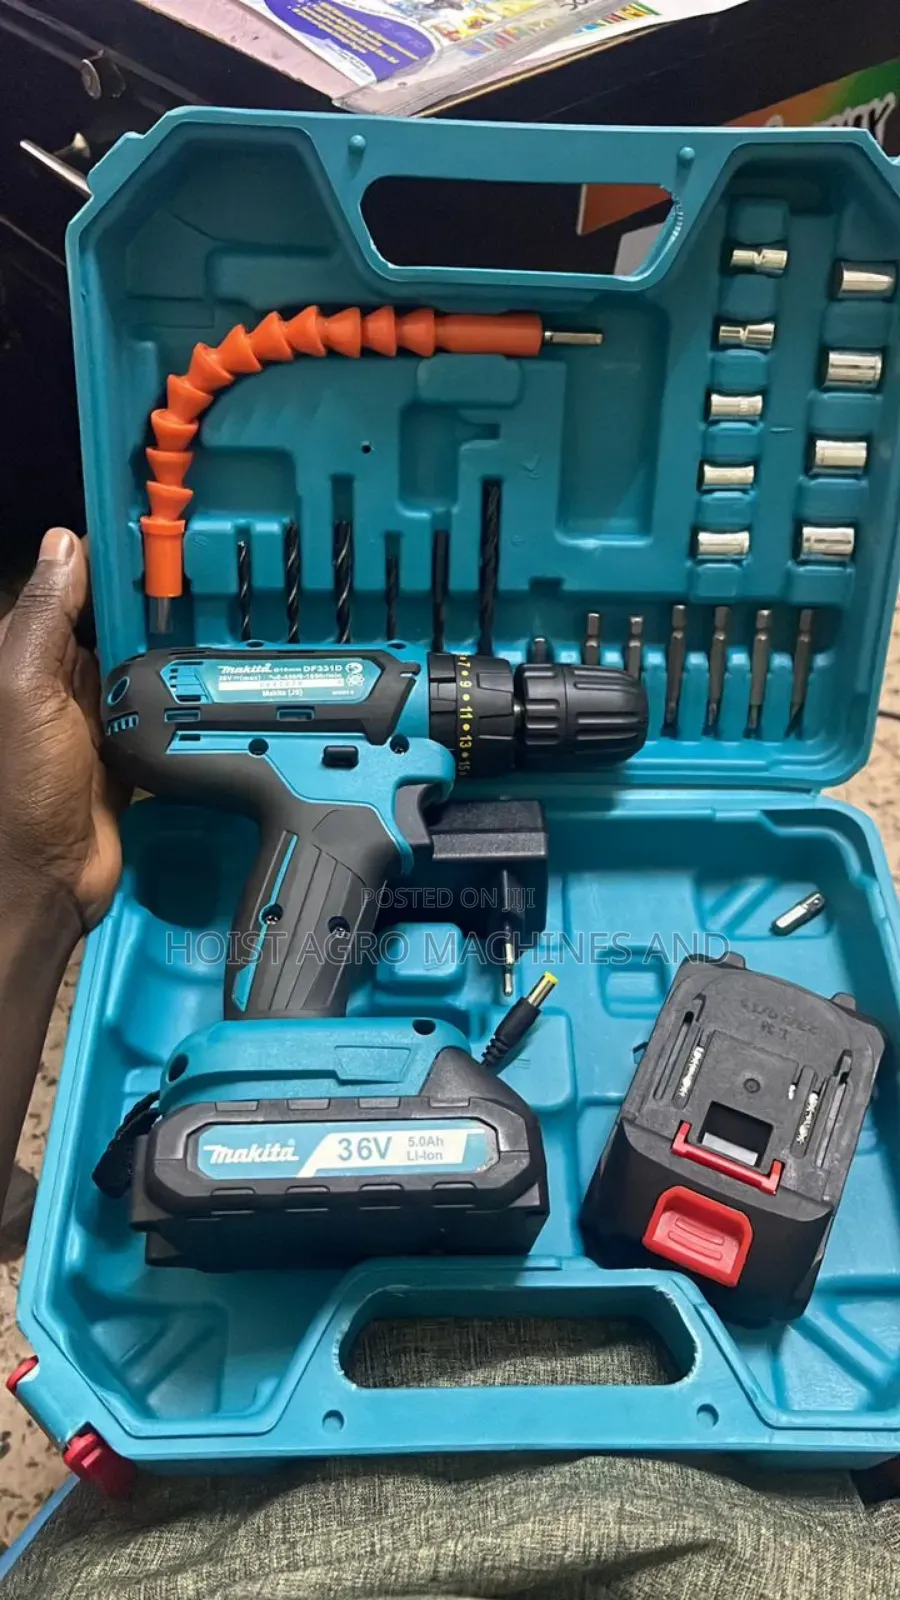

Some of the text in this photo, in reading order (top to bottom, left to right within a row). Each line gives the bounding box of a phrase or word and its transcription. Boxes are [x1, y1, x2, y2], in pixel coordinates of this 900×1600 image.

[303, 664, 343, 672] DF331D
[459, 680, 473, 688] 9
[459, 706, 474, 719] 11
[459, 734, 473, 748] 13
[408, 1135, 444, 1148] 5.0Ah
[337, 1136, 392, 1162] 36V
